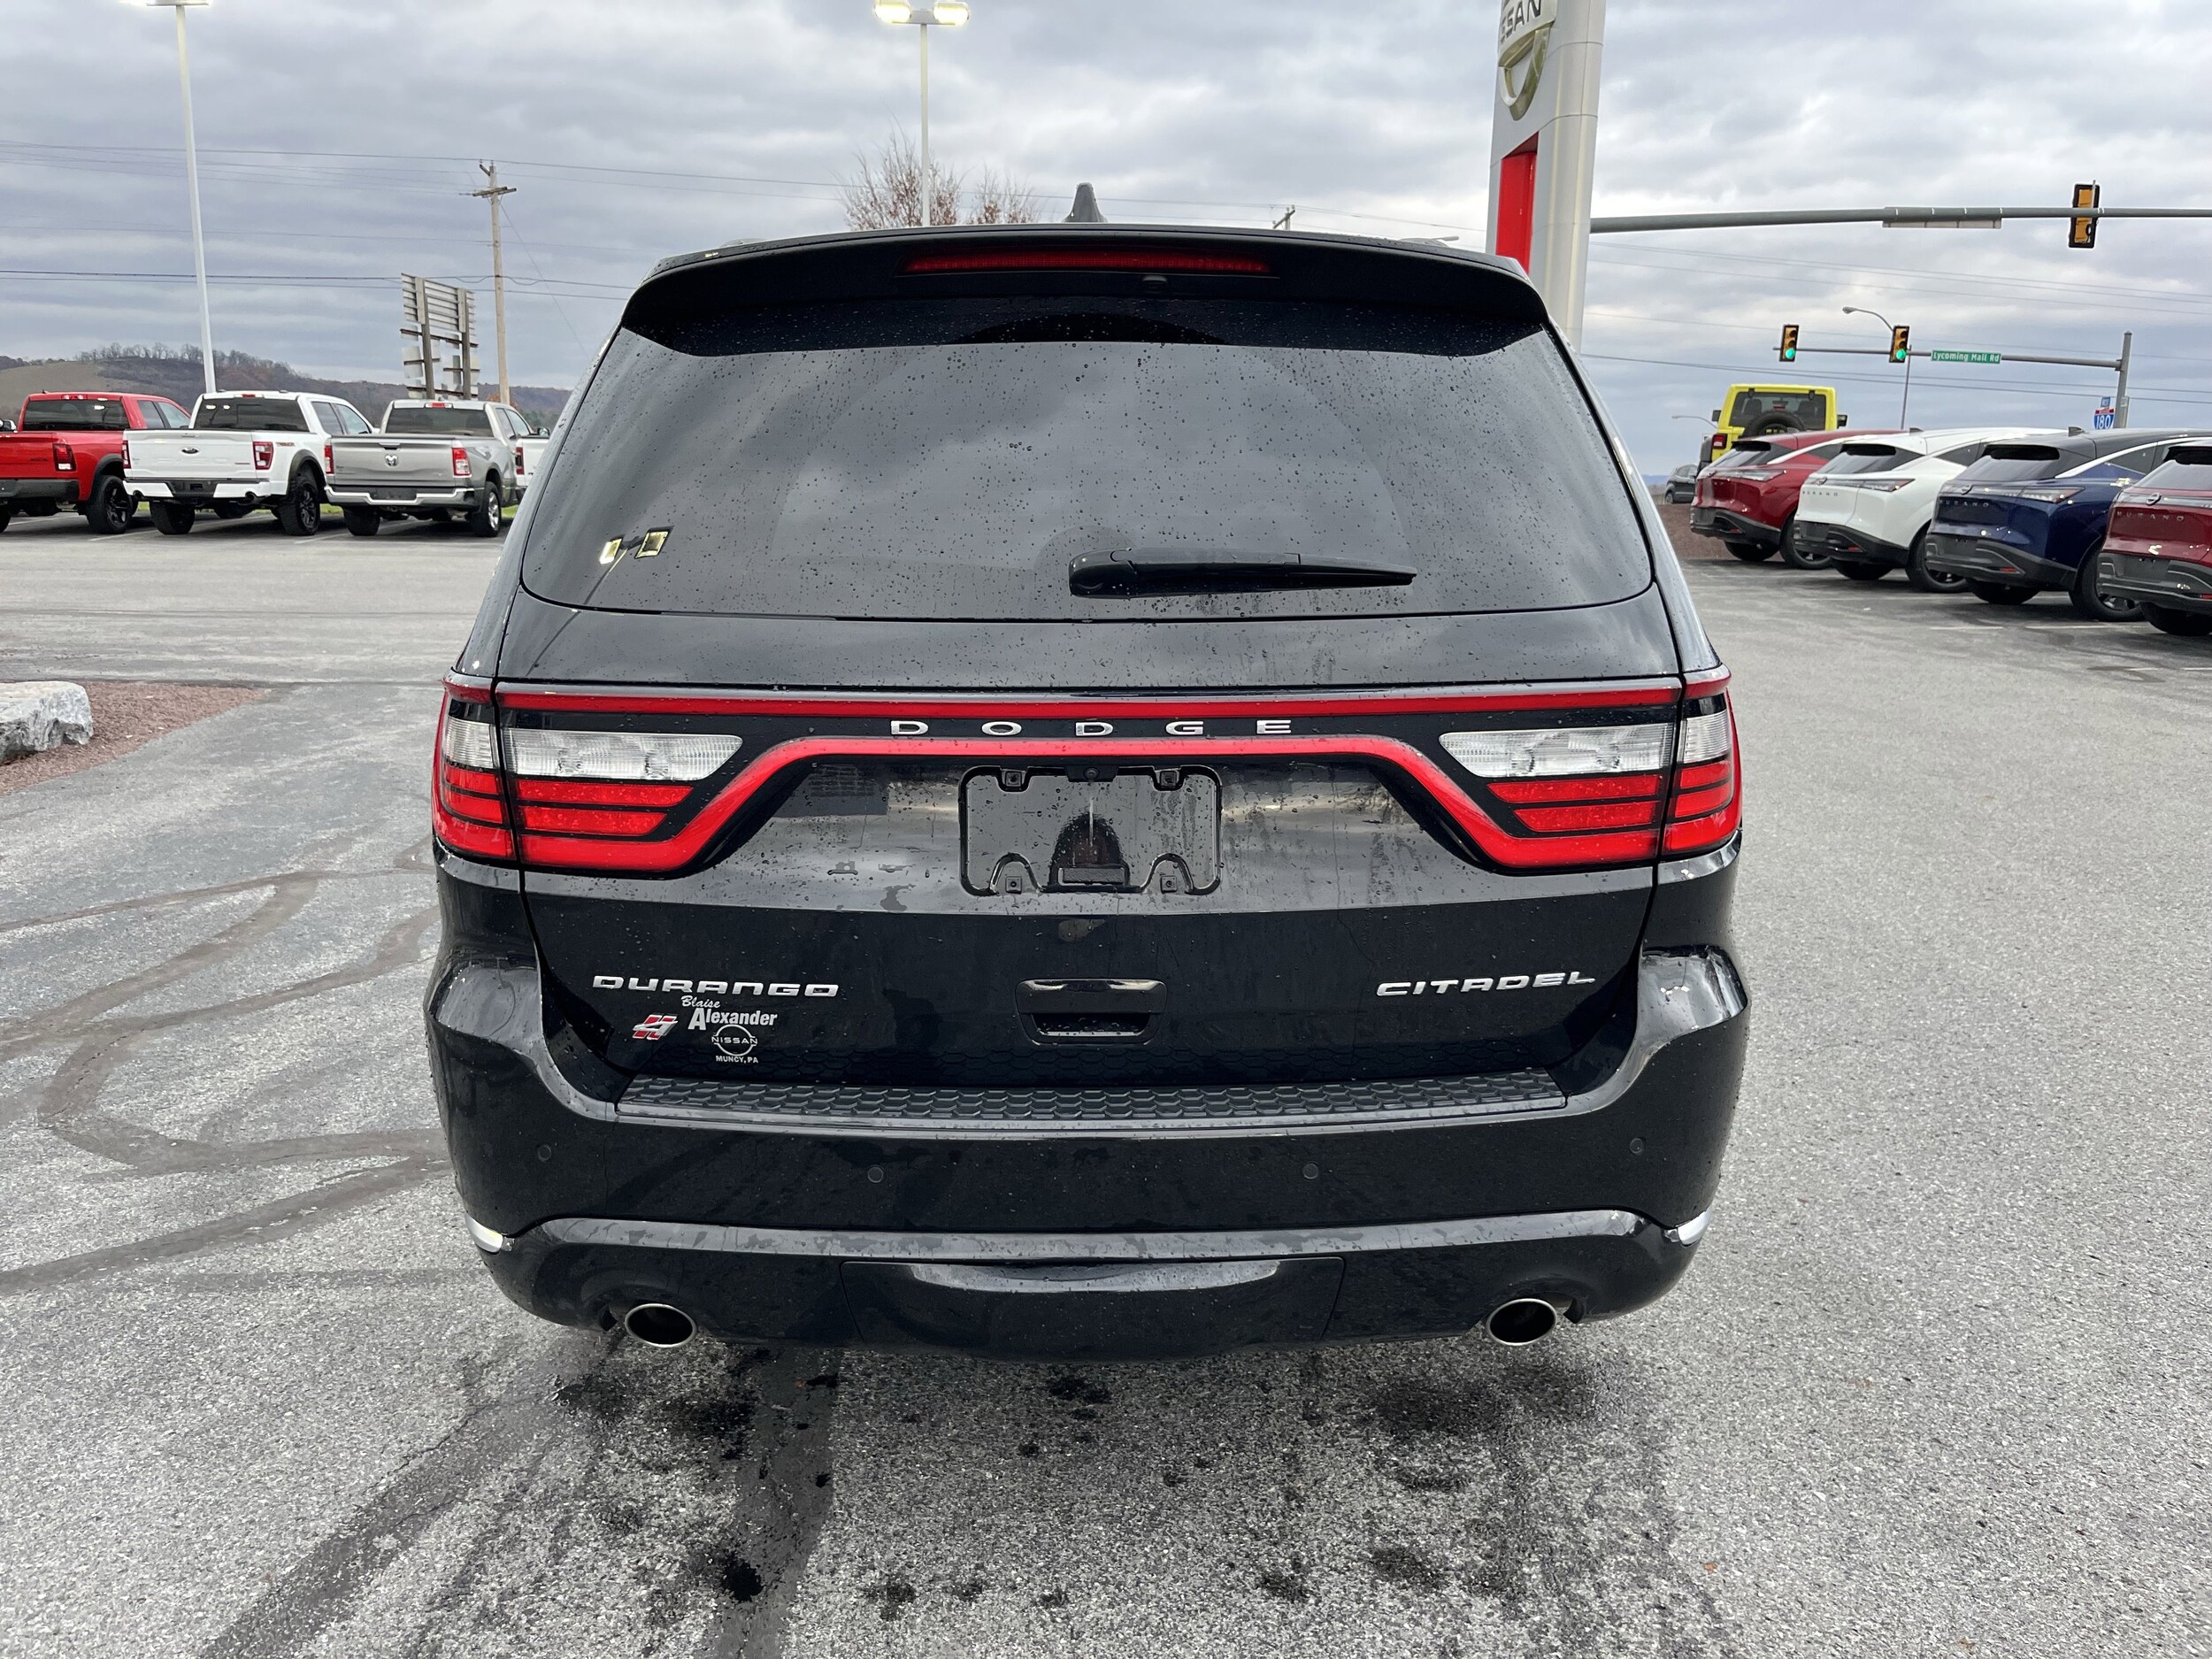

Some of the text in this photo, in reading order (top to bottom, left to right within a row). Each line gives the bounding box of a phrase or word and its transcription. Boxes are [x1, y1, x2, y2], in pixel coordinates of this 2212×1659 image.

[1933, 351, 1969, 362] Lycoming
[1971, 353, 1987, 362] Mall
[2096, 415, 2111, 429] 180
[890, 718, 1293, 736] DODGE
[592, 975, 840, 997] DURANGO
[1376, 971, 1596, 996] CITADEL
[680, 995, 721, 1009] Blaise
[687, 1007, 778, 1031] Alexander
[710, 1036, 758, 1045] NISSAN
